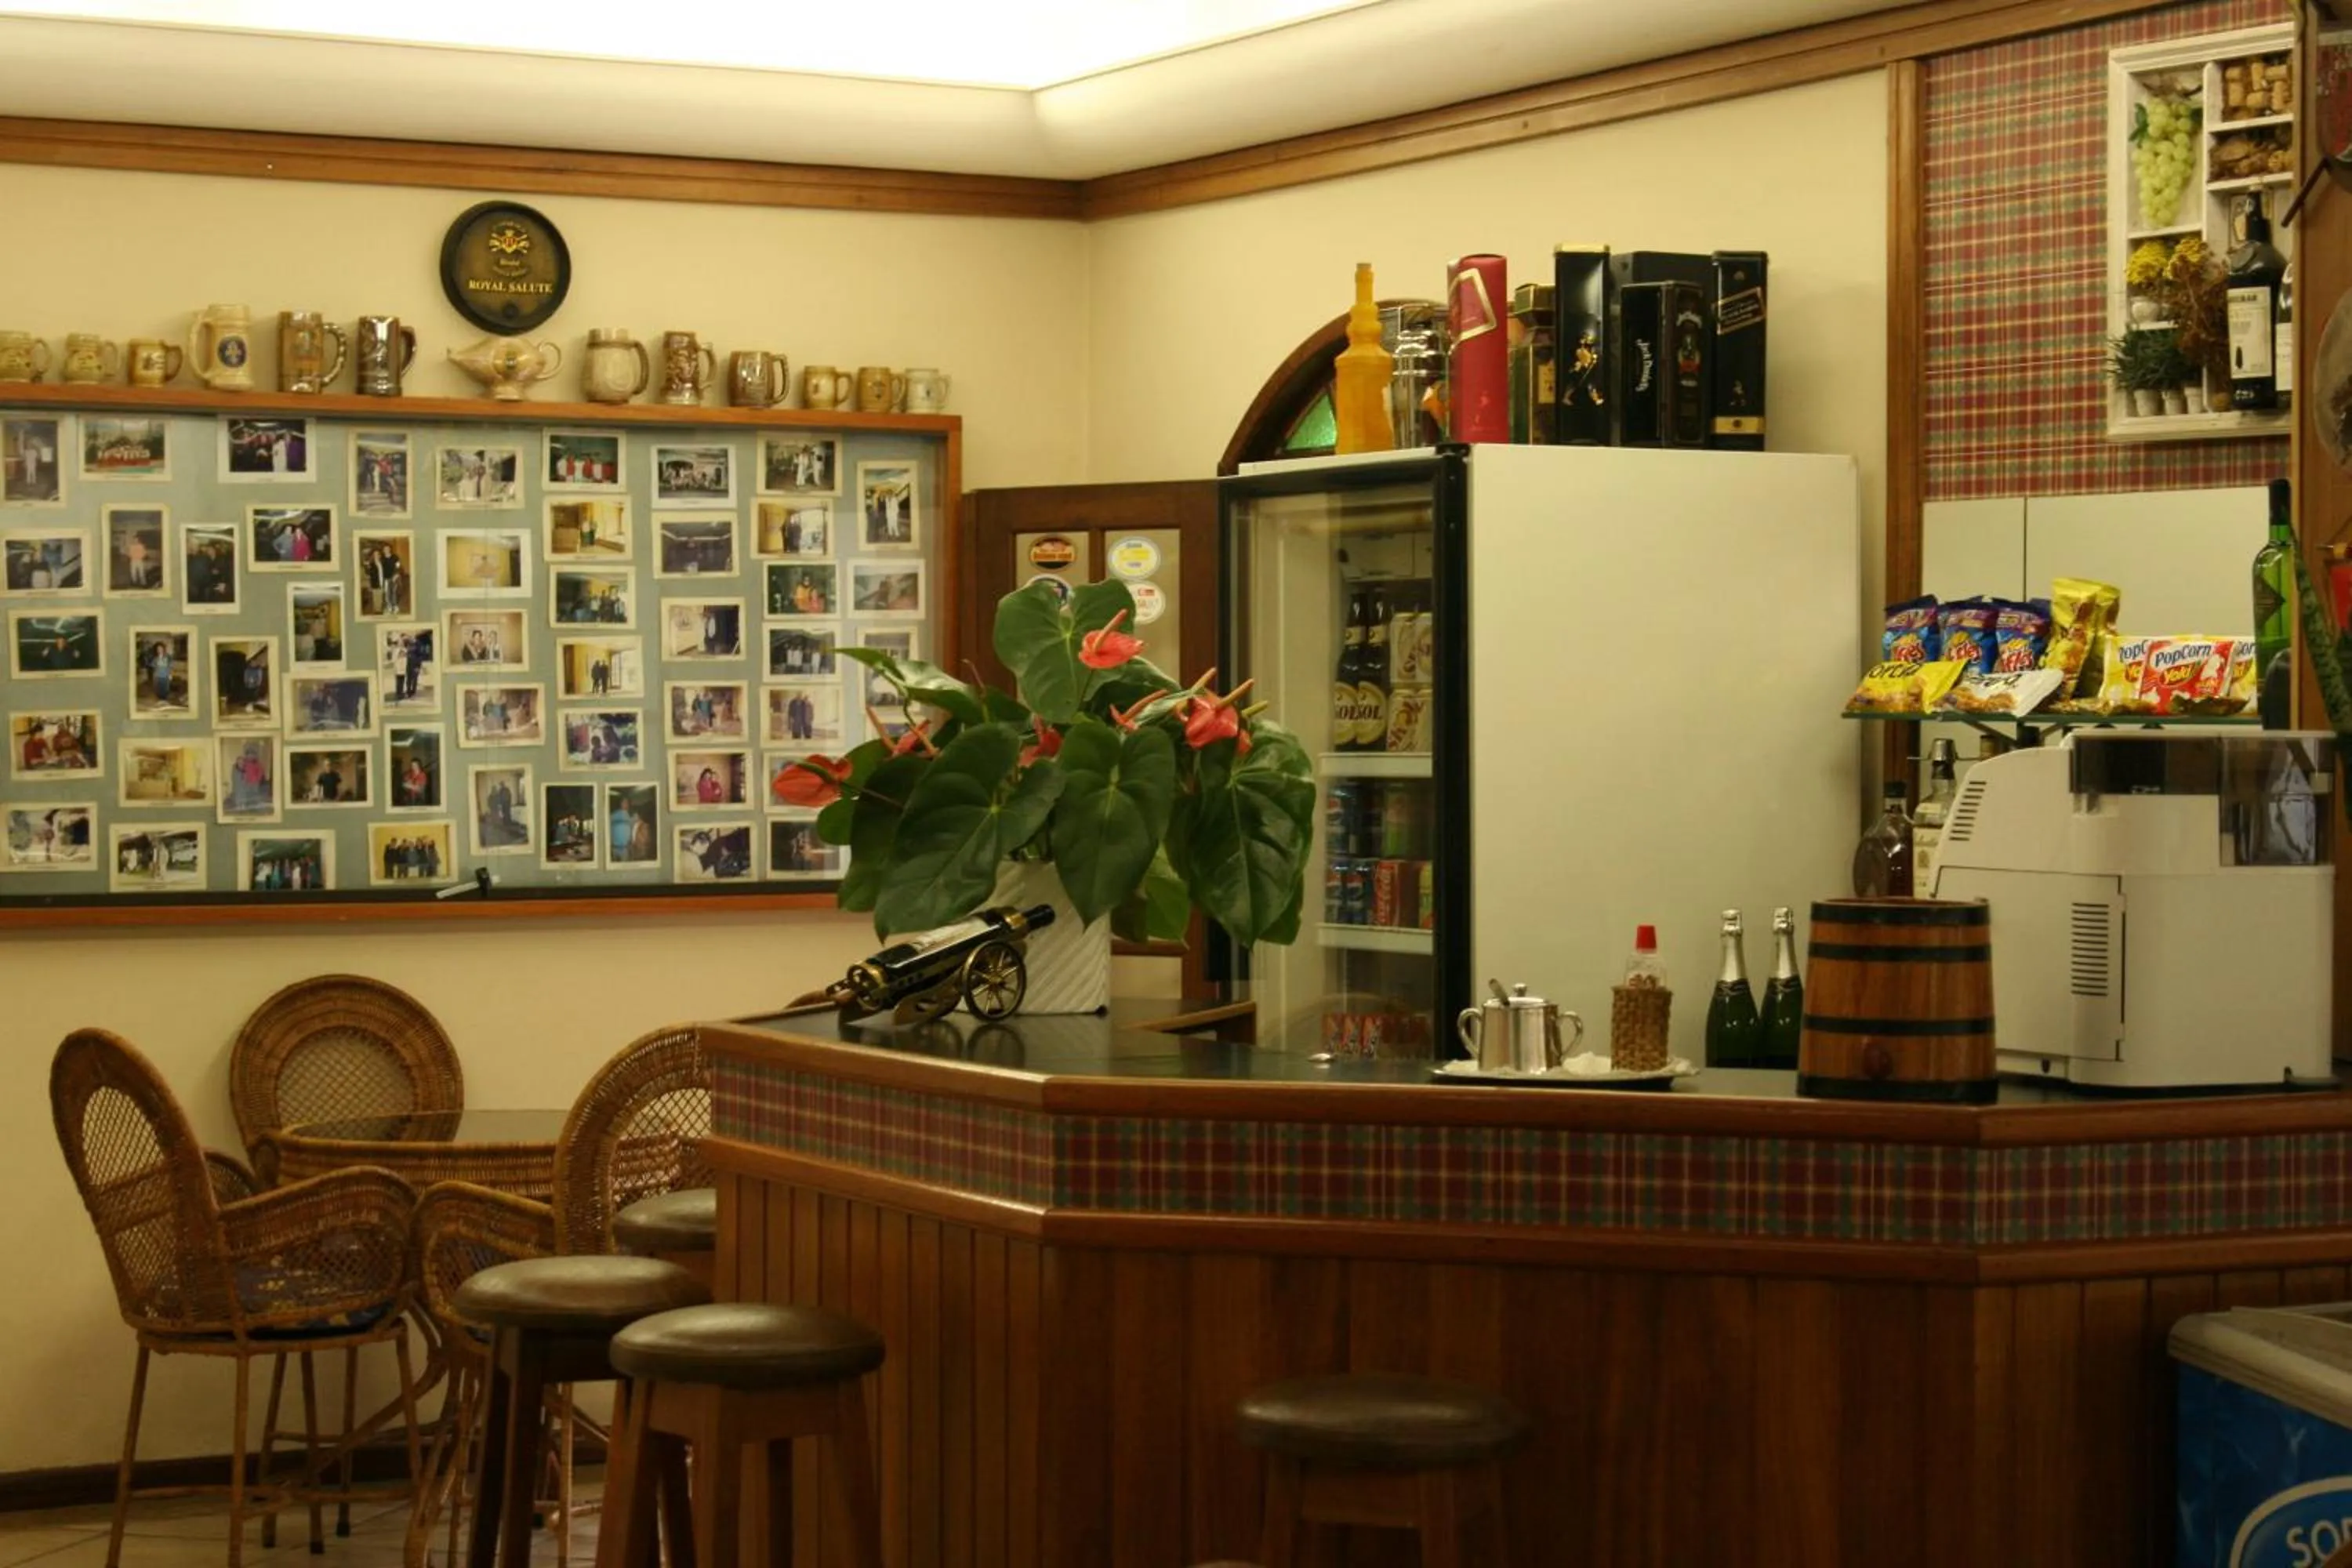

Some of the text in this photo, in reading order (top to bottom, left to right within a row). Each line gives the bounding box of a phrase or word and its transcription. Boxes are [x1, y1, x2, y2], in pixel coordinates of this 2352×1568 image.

[469, 280, 553, 293] ROYAL SALUTE
[2155, 644, 2212, 668] PopCorn
